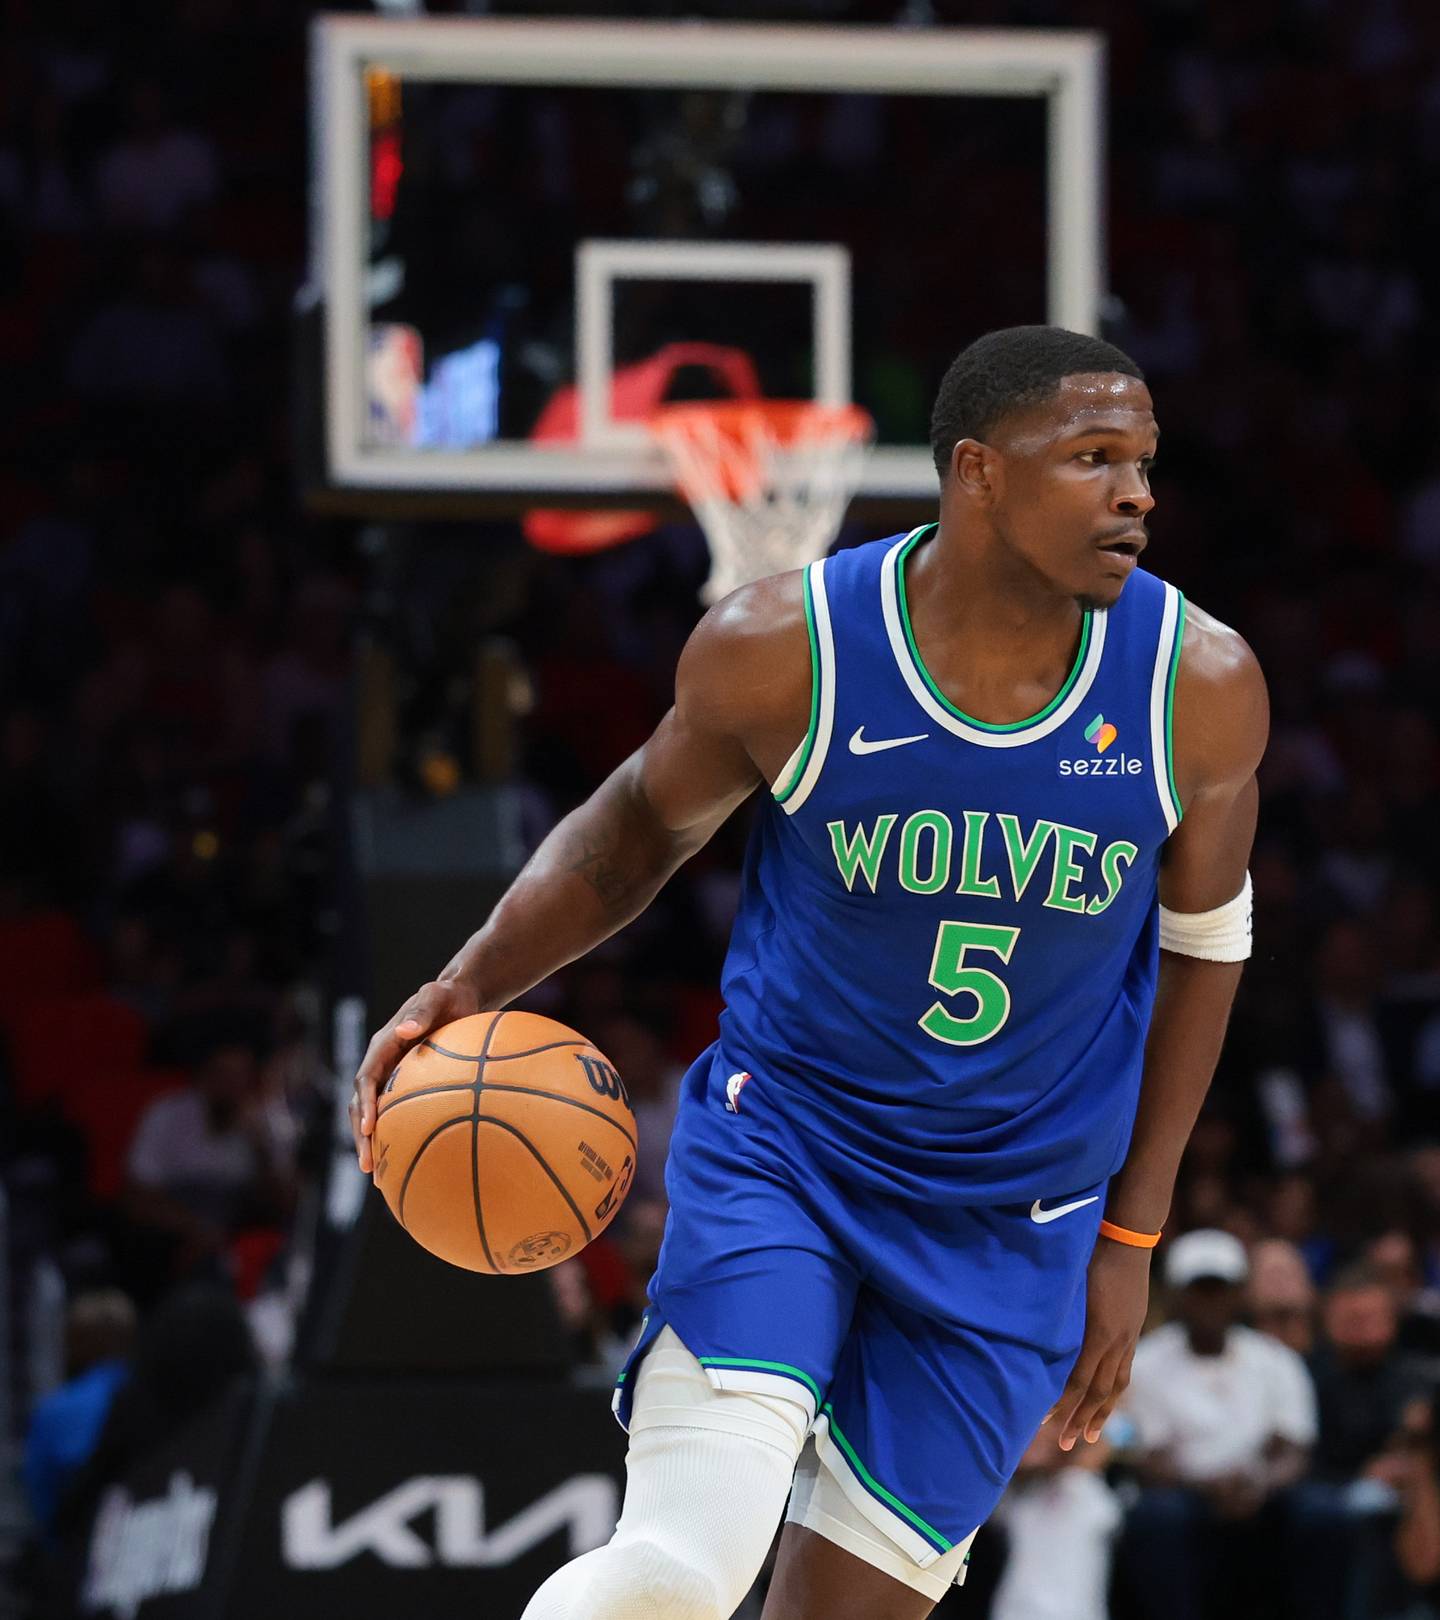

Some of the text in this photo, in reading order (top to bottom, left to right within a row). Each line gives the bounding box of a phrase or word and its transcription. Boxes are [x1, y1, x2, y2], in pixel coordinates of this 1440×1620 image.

[1059, 752, 1143, 776] sezzle
[827, 809, 1138, 915] WOLVES
[918, 920, 1021, 1046] 5
[281, 1474, 619, 1568] KIA
